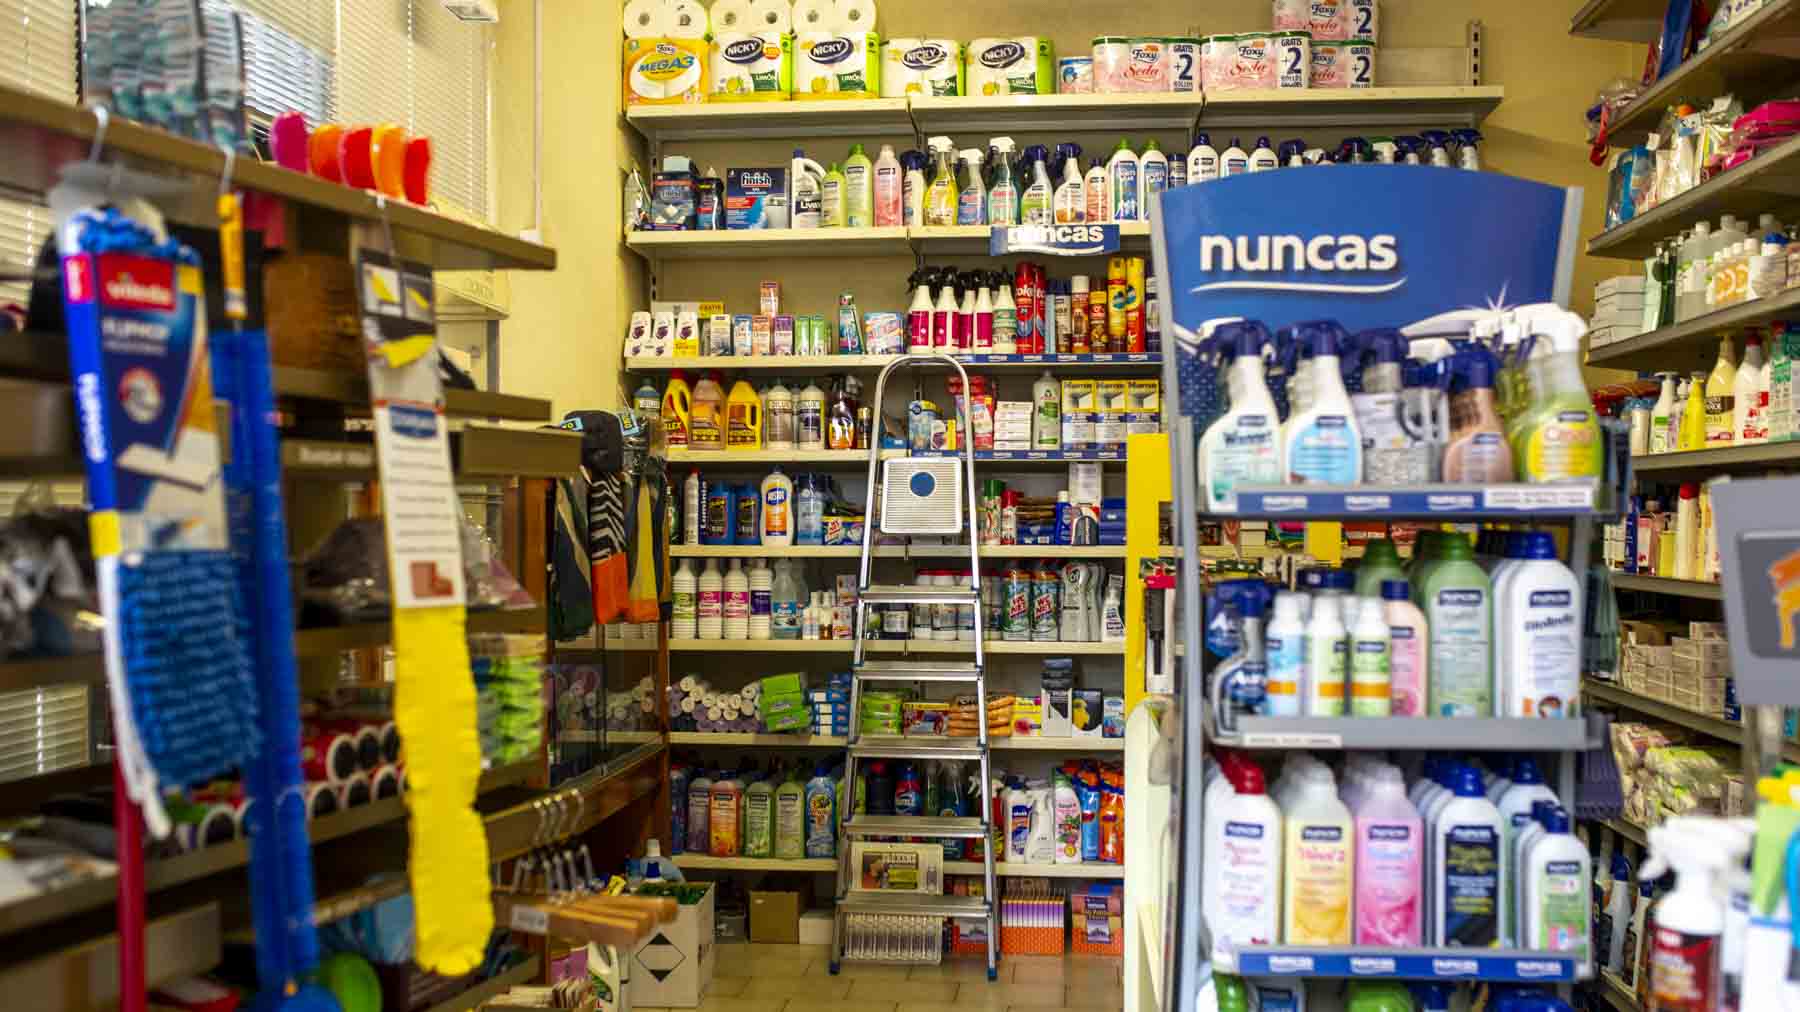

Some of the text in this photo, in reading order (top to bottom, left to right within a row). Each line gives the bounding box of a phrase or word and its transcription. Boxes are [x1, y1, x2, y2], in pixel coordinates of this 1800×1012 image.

[727, 42, 757, 55] NICKY
[813, 42, 843, 56] NICKY
[1280, 38, 1302, 47] GRATIS
[984, 47, 1014, 61] NICKY
[1132, 48, 1159, 61] Foxy
[1239, 46, 1264, 58] Foxy
[638, 54, 695, 72] MEGA3
[1173, 53, 1193, 80] +2
[1280, 47, 1302, 74] +2
[1352, 55, 1370, 82] +2
[740, 172, 771, 185] finish
[1200, 234, 1398, 271] nuncas
